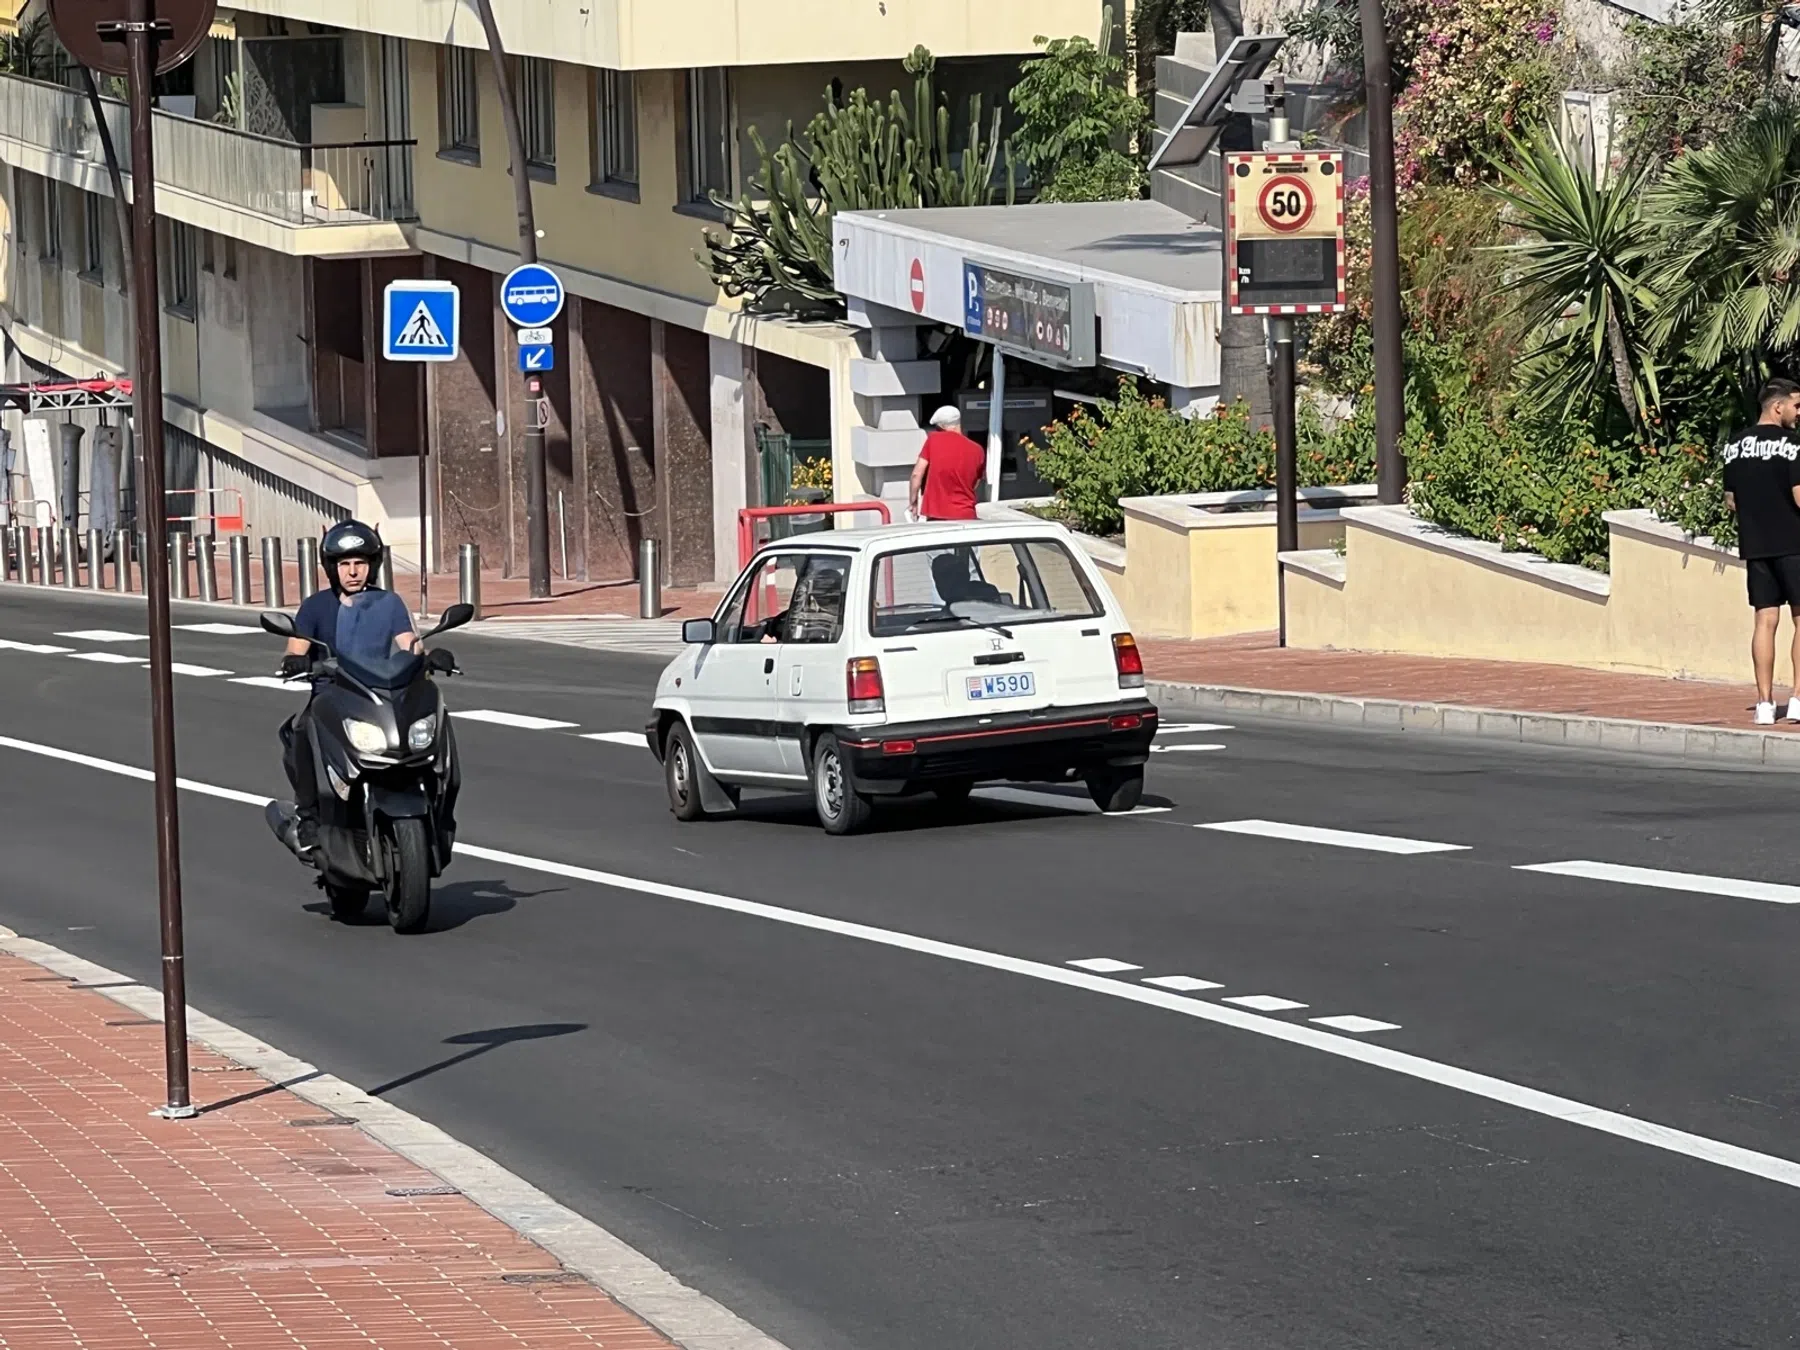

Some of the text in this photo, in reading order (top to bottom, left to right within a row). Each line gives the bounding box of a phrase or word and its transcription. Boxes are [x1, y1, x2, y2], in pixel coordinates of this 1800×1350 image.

[1271, 191, 1301, 217] 50
[1740, 435, 1800, 461] Angeles
[984, 675, 1029, 693] W590
